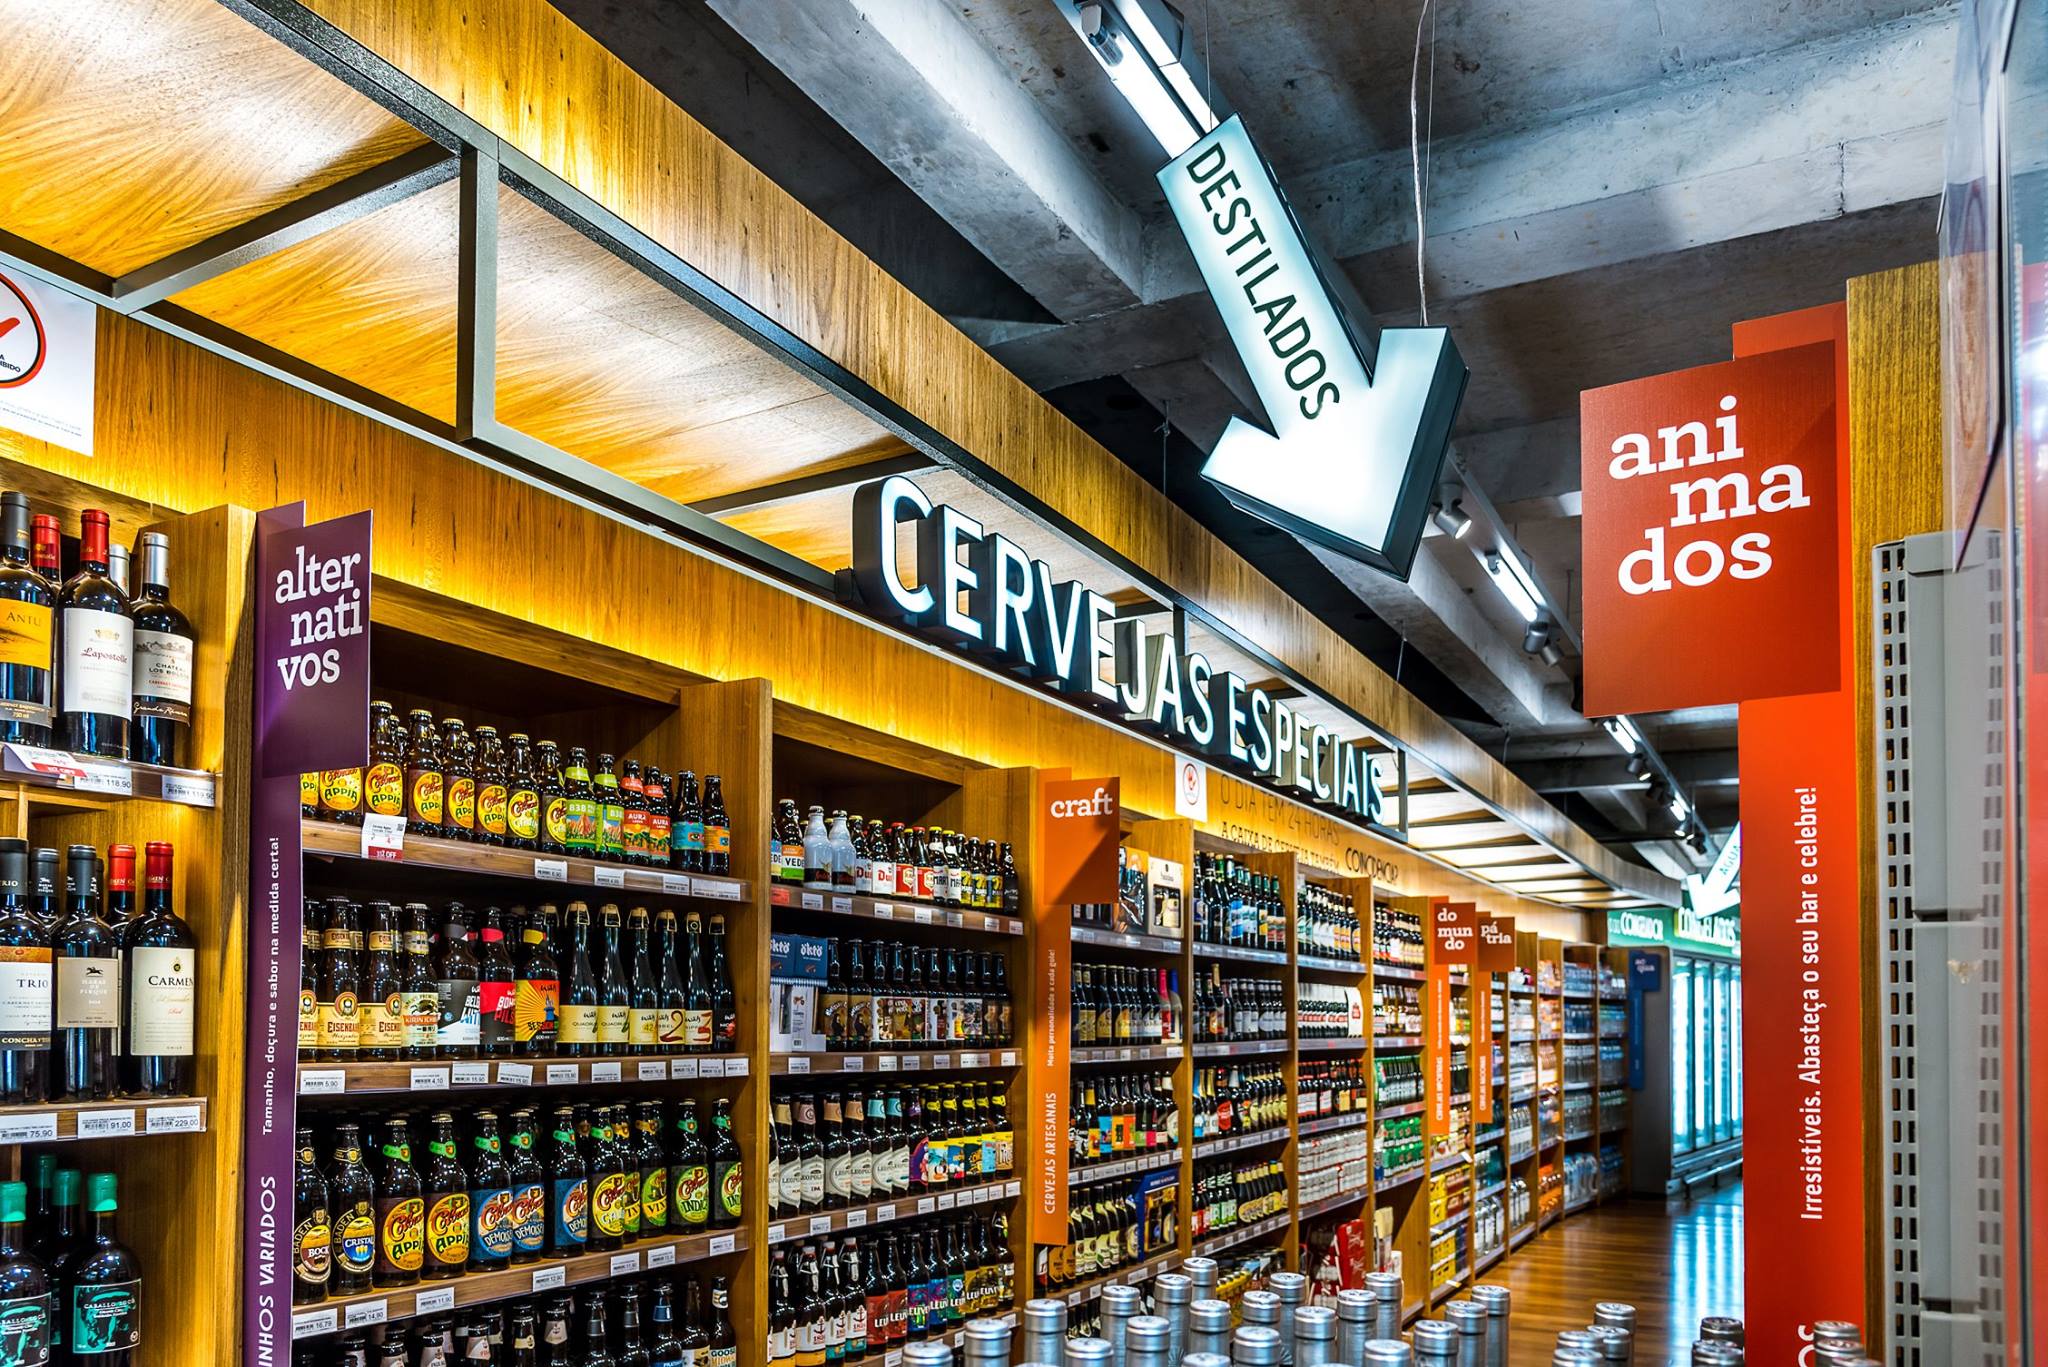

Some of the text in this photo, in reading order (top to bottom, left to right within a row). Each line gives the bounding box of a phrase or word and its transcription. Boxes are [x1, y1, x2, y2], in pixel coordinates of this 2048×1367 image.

[1186, 142, 1340, 420] DESTILADOS
[0, 361, 21, 373] IBIDO
[1608, 395, 1744, 480] ani
[1669, 464, 1811, 528] ma
[275, 545, 362, 605] alter
[1617, 526, 1773, 595] dos
[289, 587, 363, 648] nati
[81, 647, 129, 664] Lapostolle
[277, 648, 341, 691] vos
[878, 475, 1385, 826] CERVEJAS ESPECIAIS
[1050, 787, 1114, 819] craft
[1235, 778, 1258, 814] DIA
[1437, 907, 1458, 922] do
[1437, 925, 1473, 938] mun
[1481, 921, 1498, 938] pá
[1444, 937, 1465, 950] do
[1486, 931, 1512, 944] tria
[16, 978, 49, 989] TRIO
[148, 975, 194, 987] CARMEN
[262, 836, 280, 1135] Tamanho, doçura e sabor na medida certa!
[1794, 787, 1827, 1220] Irresistíveis. Abasteça o seu bar e celebre!
[1044, 1092, 1057, 1214] CERVEJAS ARTESANAIS
[333, 1212, 356, 1244] BADEN
[258, 1175, 276, 1367] INHOS VARIADOS
